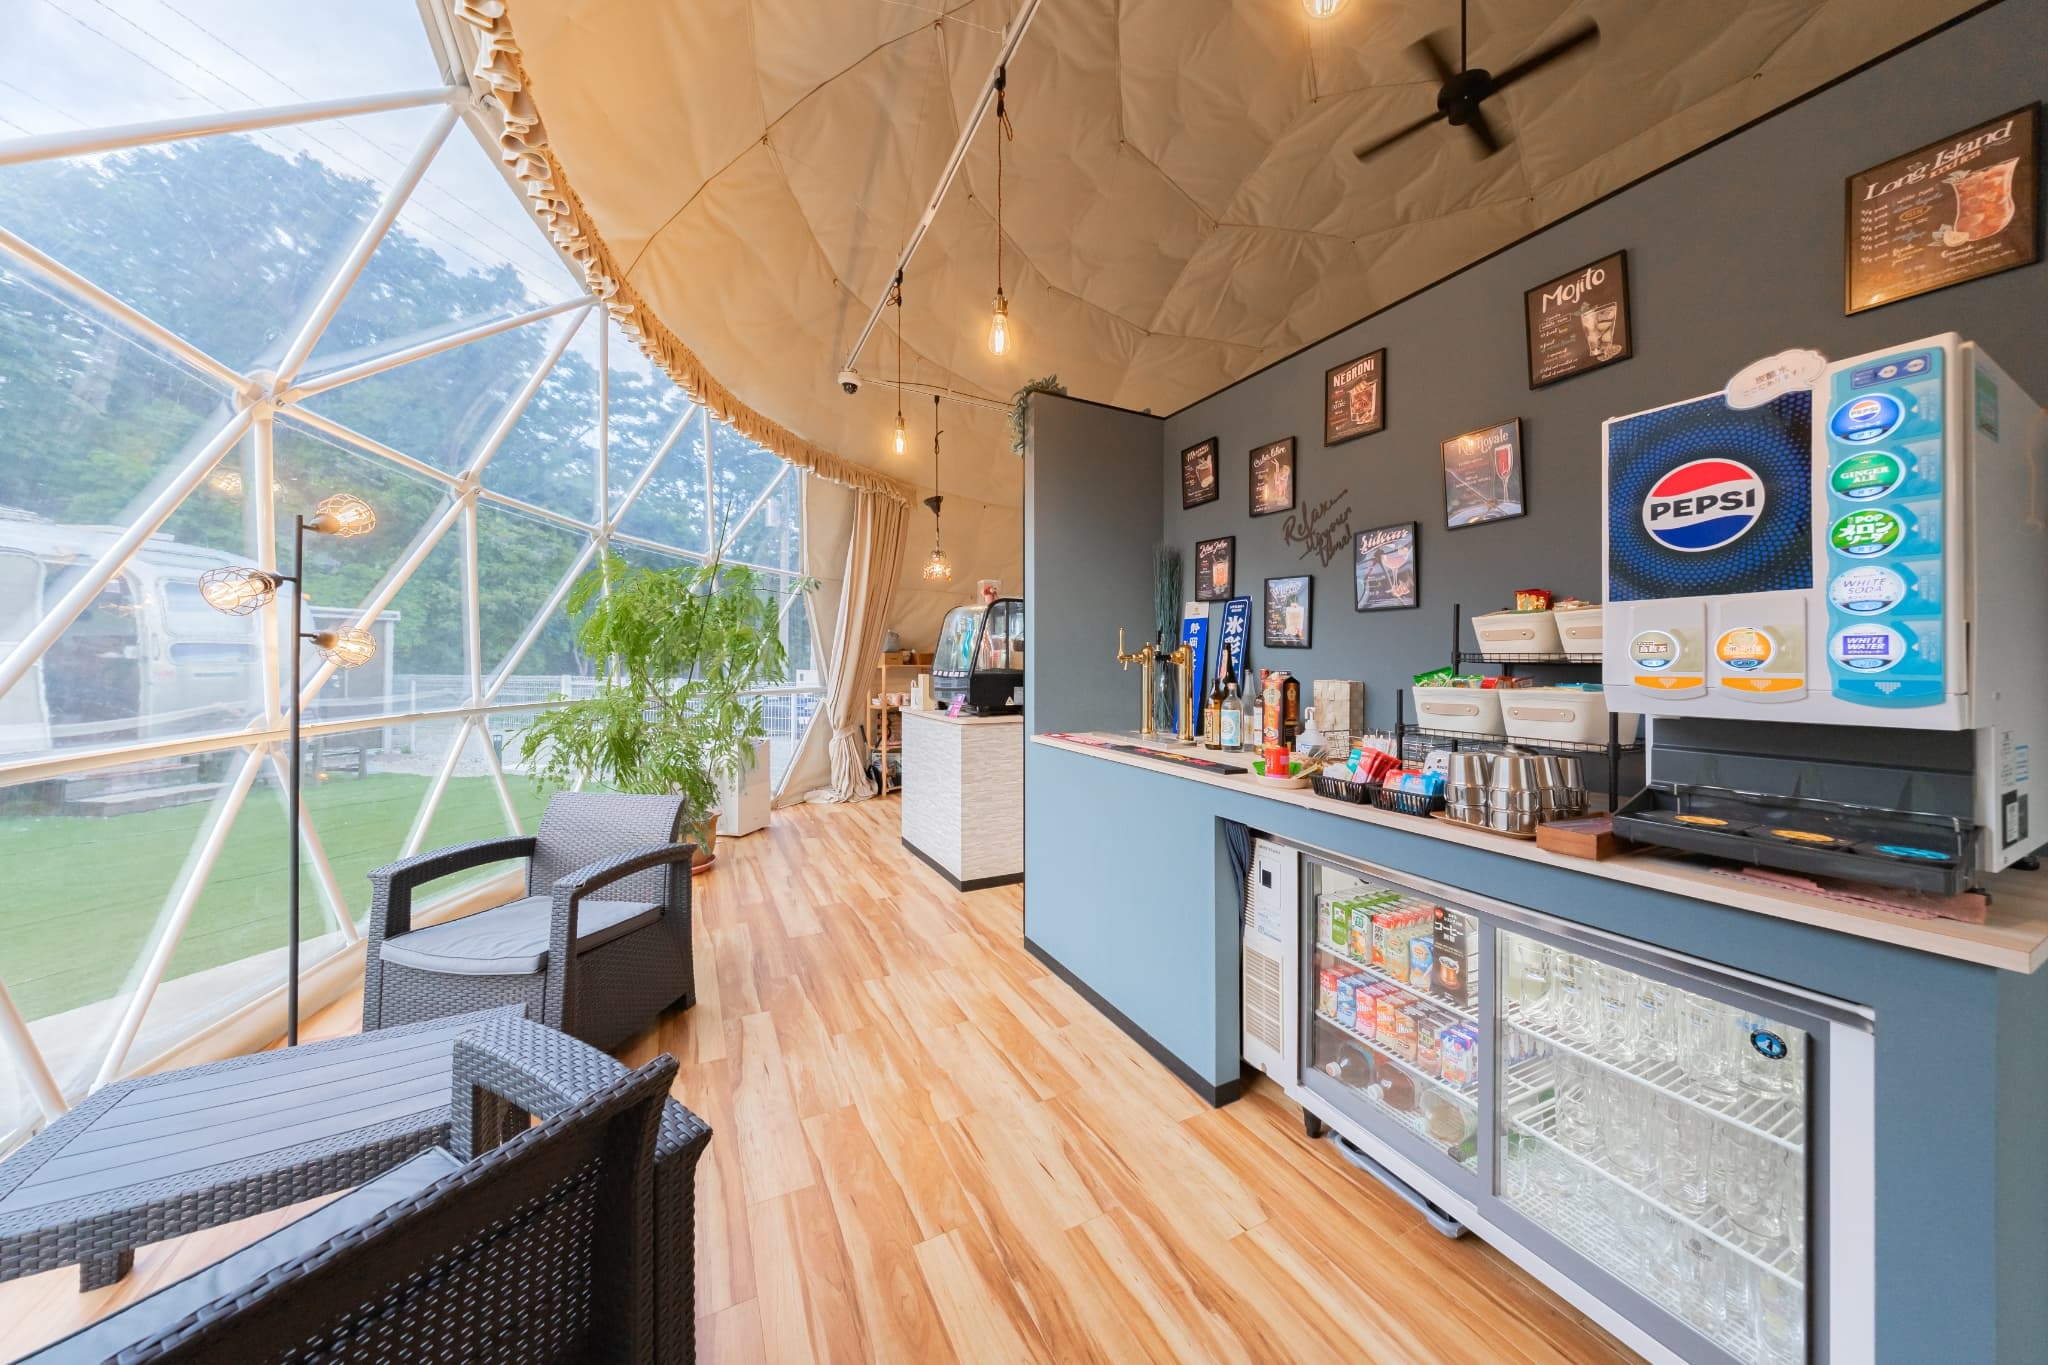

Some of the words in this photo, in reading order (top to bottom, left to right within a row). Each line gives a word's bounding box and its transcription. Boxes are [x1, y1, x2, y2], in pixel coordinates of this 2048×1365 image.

[1864, 163, 1931, 201] Long
[1931, 120, 2014, 170] Island
[1542, 267, 1606, 314] Mojito
[1333, 359, 1375, 387] NEGRONI
[1840, 466, 1890, 480] GINGER
[1853, 474, 1878, 483] ALE
[1650, 488, 1756, 521] PEPSI
[1855, 514, 1884, 523] POP
[1838, 522, 1894, 538] メロン
[1846, 531, 1888, 545] ソーダ
[1843, 578, 1888, 588] WHITE
[1847, 586, 1883, 595] SODA
